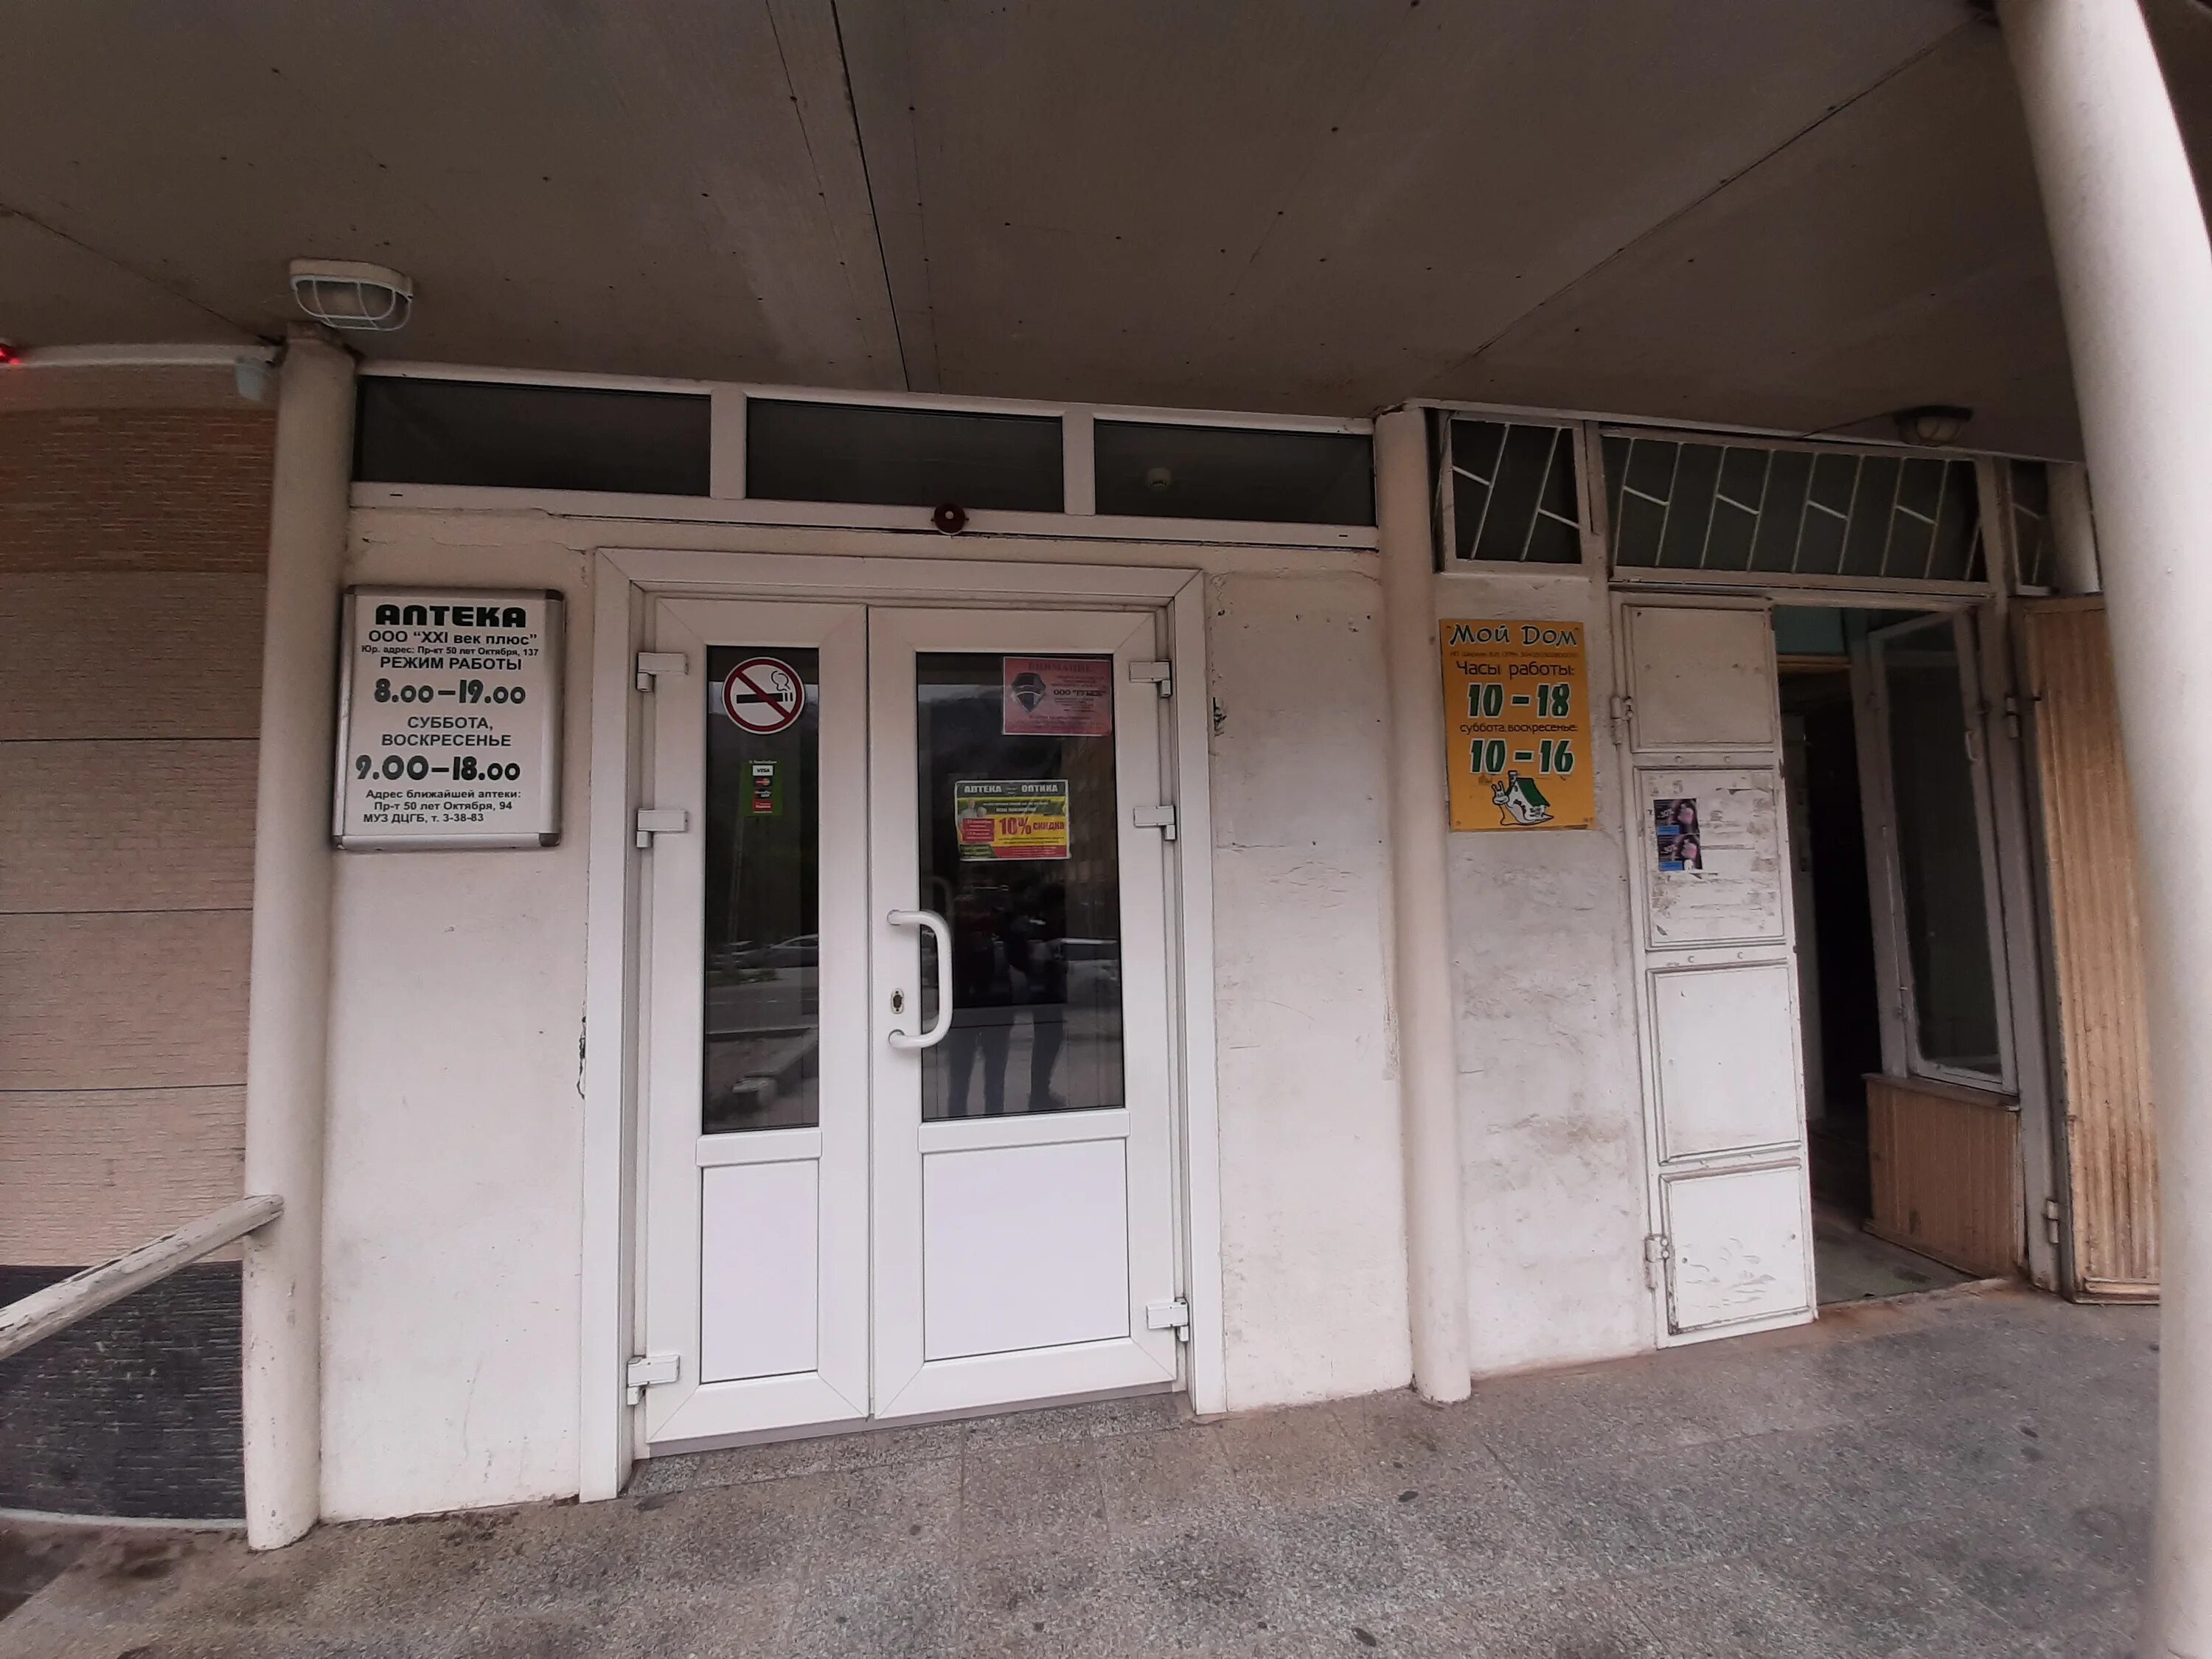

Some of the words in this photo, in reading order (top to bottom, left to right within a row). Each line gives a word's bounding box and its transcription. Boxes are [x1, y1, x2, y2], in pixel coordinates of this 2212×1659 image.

[375, 604, 526, 627] АПТЕКА
[369, 630, 408, 642] ООО
[454, 636, 481, 644] век
[1450, 624, 1510, 645] Мой
[361, 645, 380, 654] Юр.
[478, 647, 520, 656] Октября,
[524, 648, 538, 656] 137
[380, 657, 444, 669] РЕЖИМ
[449, 657, 521, 670] РАБОТЫ
[1456, 661, 1500, 675] Часы
[1509, 661, 1575, 679] работы:
[1467, 683, 1503, 718] 10
[1537, 683, 1571, 718] 18
[407, 717, 493, 730] СУББОТА,
[381, 734, 511, 746] ВОСКРЕСЕНЬЕ
[1470, 739, 1506, 774] 10
[1539, 739, 1575, 774] 16
[366, 790, 403, 800] Адрес
[406, 790, 474, 799] ближайшей
[964, 785, 1002, 793] АПТЕКА
[1021, 785, 1058, 793] ОПТИКА
[374, 801, 400, 811] Пр-т
[403, 801, 417, 810] 50
[443, 801, 495, 811] Октября,
[499, 801, 512, 810] 94
[364, 813, 388, 822] МУЗ
[392, 813, 428, 824] ДЦГБ,
[442, 813, 484, 822] 3-38-83
[1000, 817, 1032, 835] 10%
[1033, 821, 1065, 831] скидка
